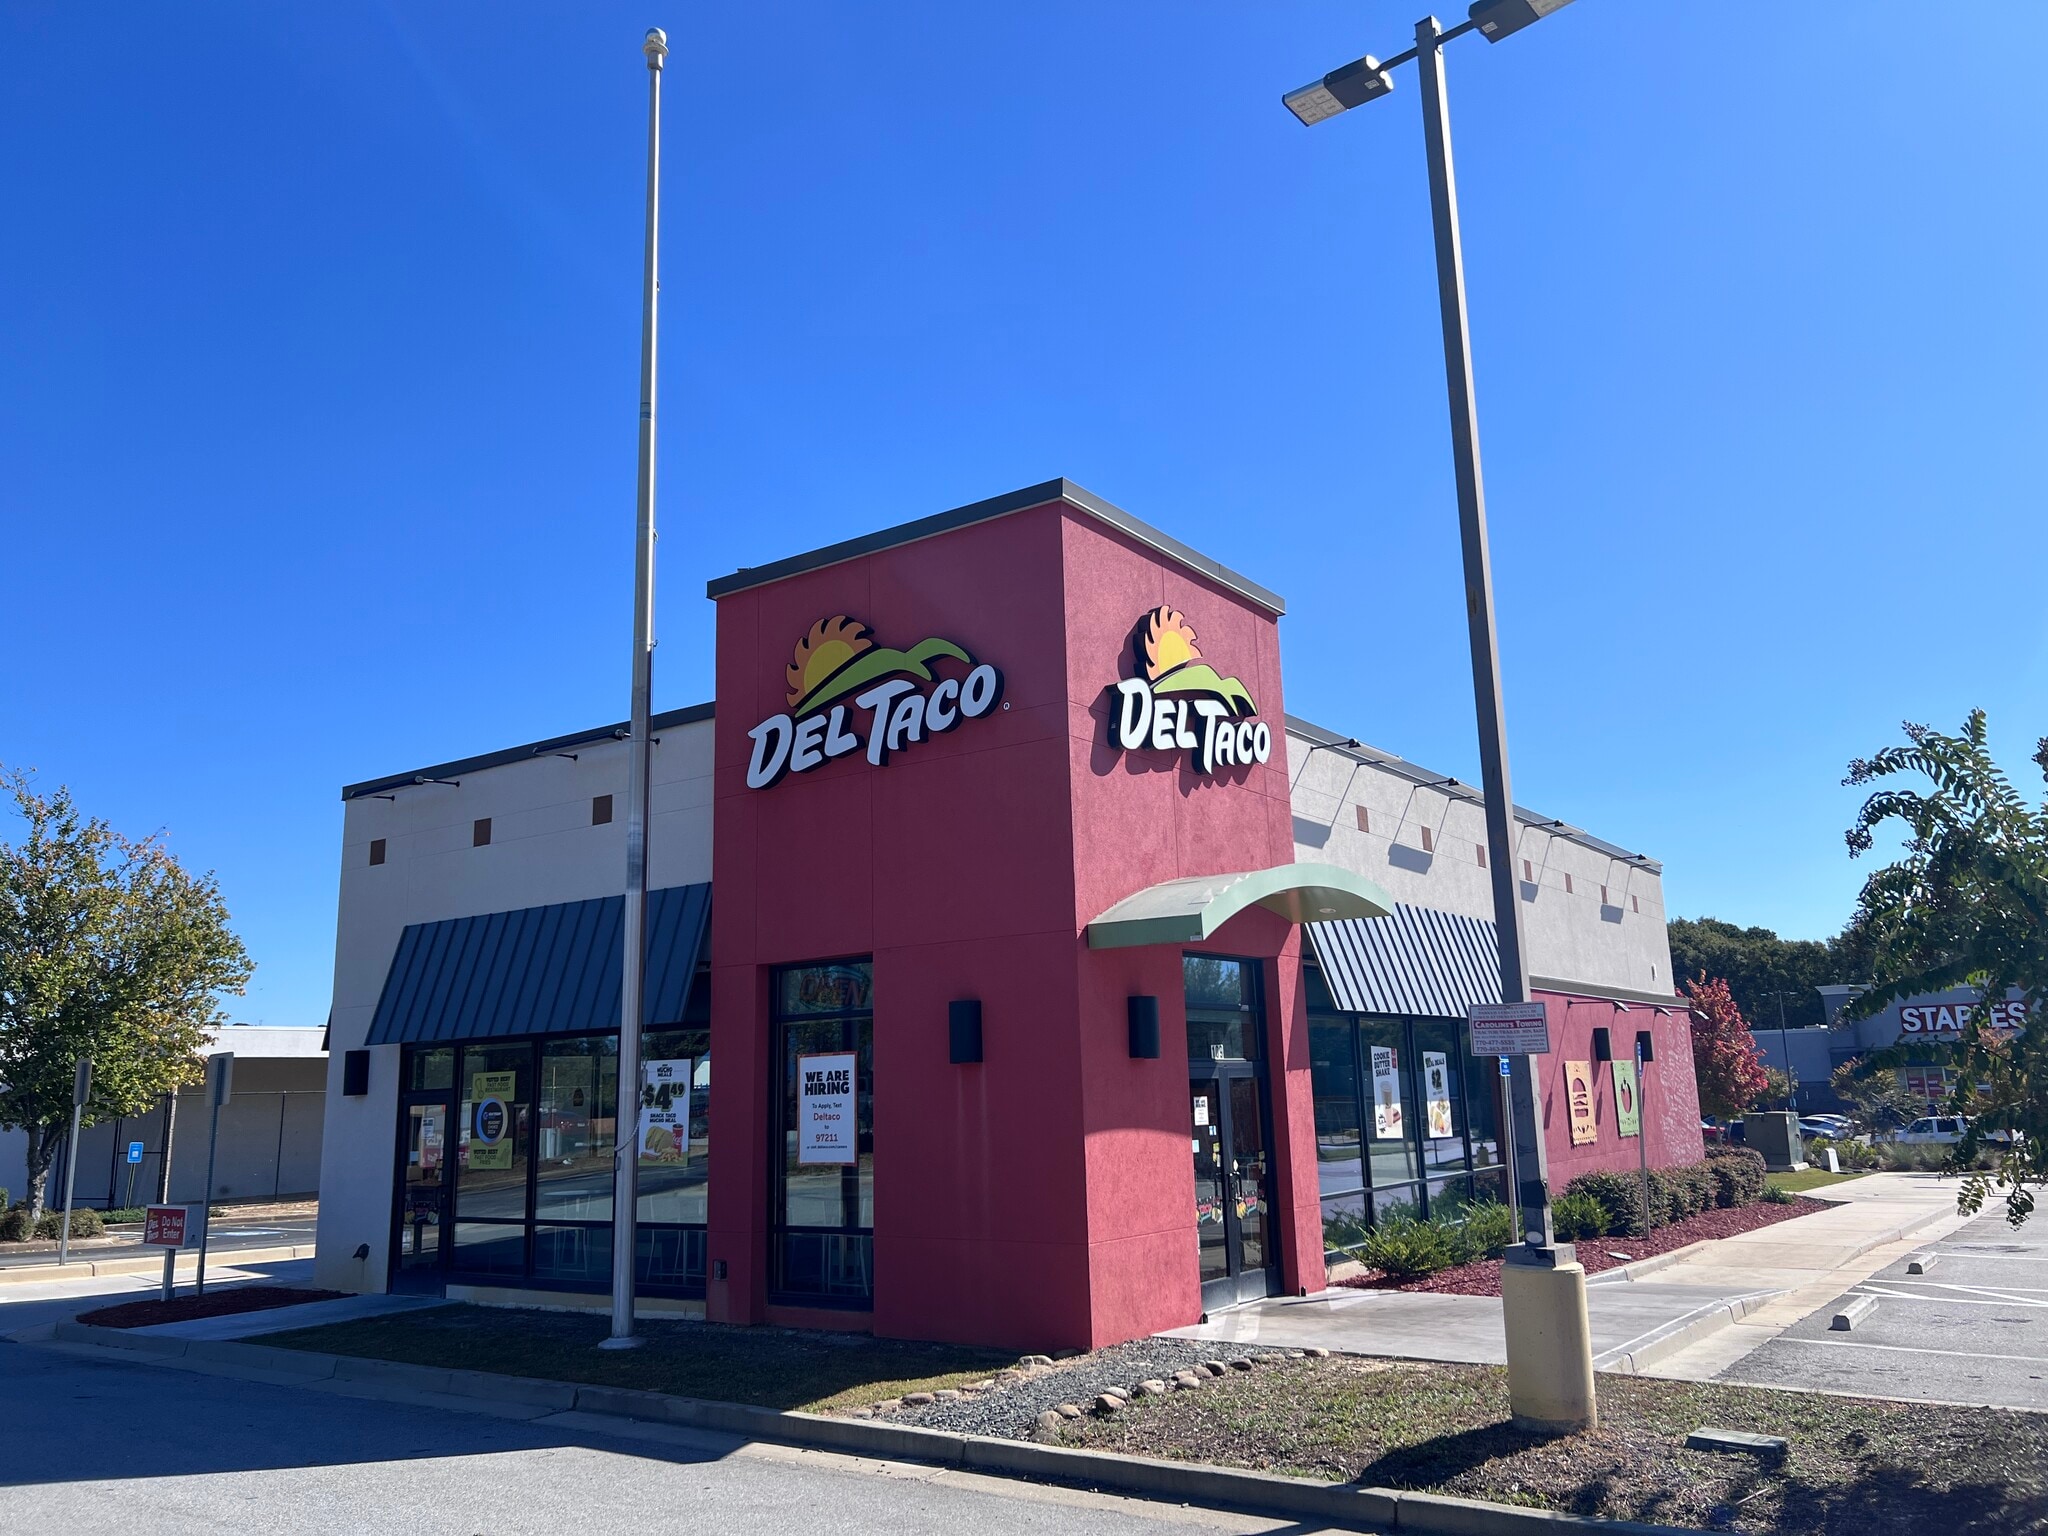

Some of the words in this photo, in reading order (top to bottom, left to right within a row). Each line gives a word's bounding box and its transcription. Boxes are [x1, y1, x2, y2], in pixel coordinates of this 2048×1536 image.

[746, 705, 858, 789] DEL
[855, 664, 997, 766] TACO
[1116, 677, 1198, 750] DEL
[1194, 699, 1271, 775] TACO
[1902, 1002, 2027, 1032] STAPES
[1374, 1052, 1390, 1060] COOKIE
[1374, 1060, 1390, 1069] BUTTER
[806, 1071, 823, 1082] WE
[826, 1070, 849, 1081] ARE
[1376, 1068, 1390, 1077] SHAKE
[805, 1081, 849, 1096] HIRING
[816, 1134, 838, 1142] 97211
[162, 1216, 171, 1226] Do
[172, 1216, 183, 1227] Not
[163, 1228, 180, 1238] Enter
